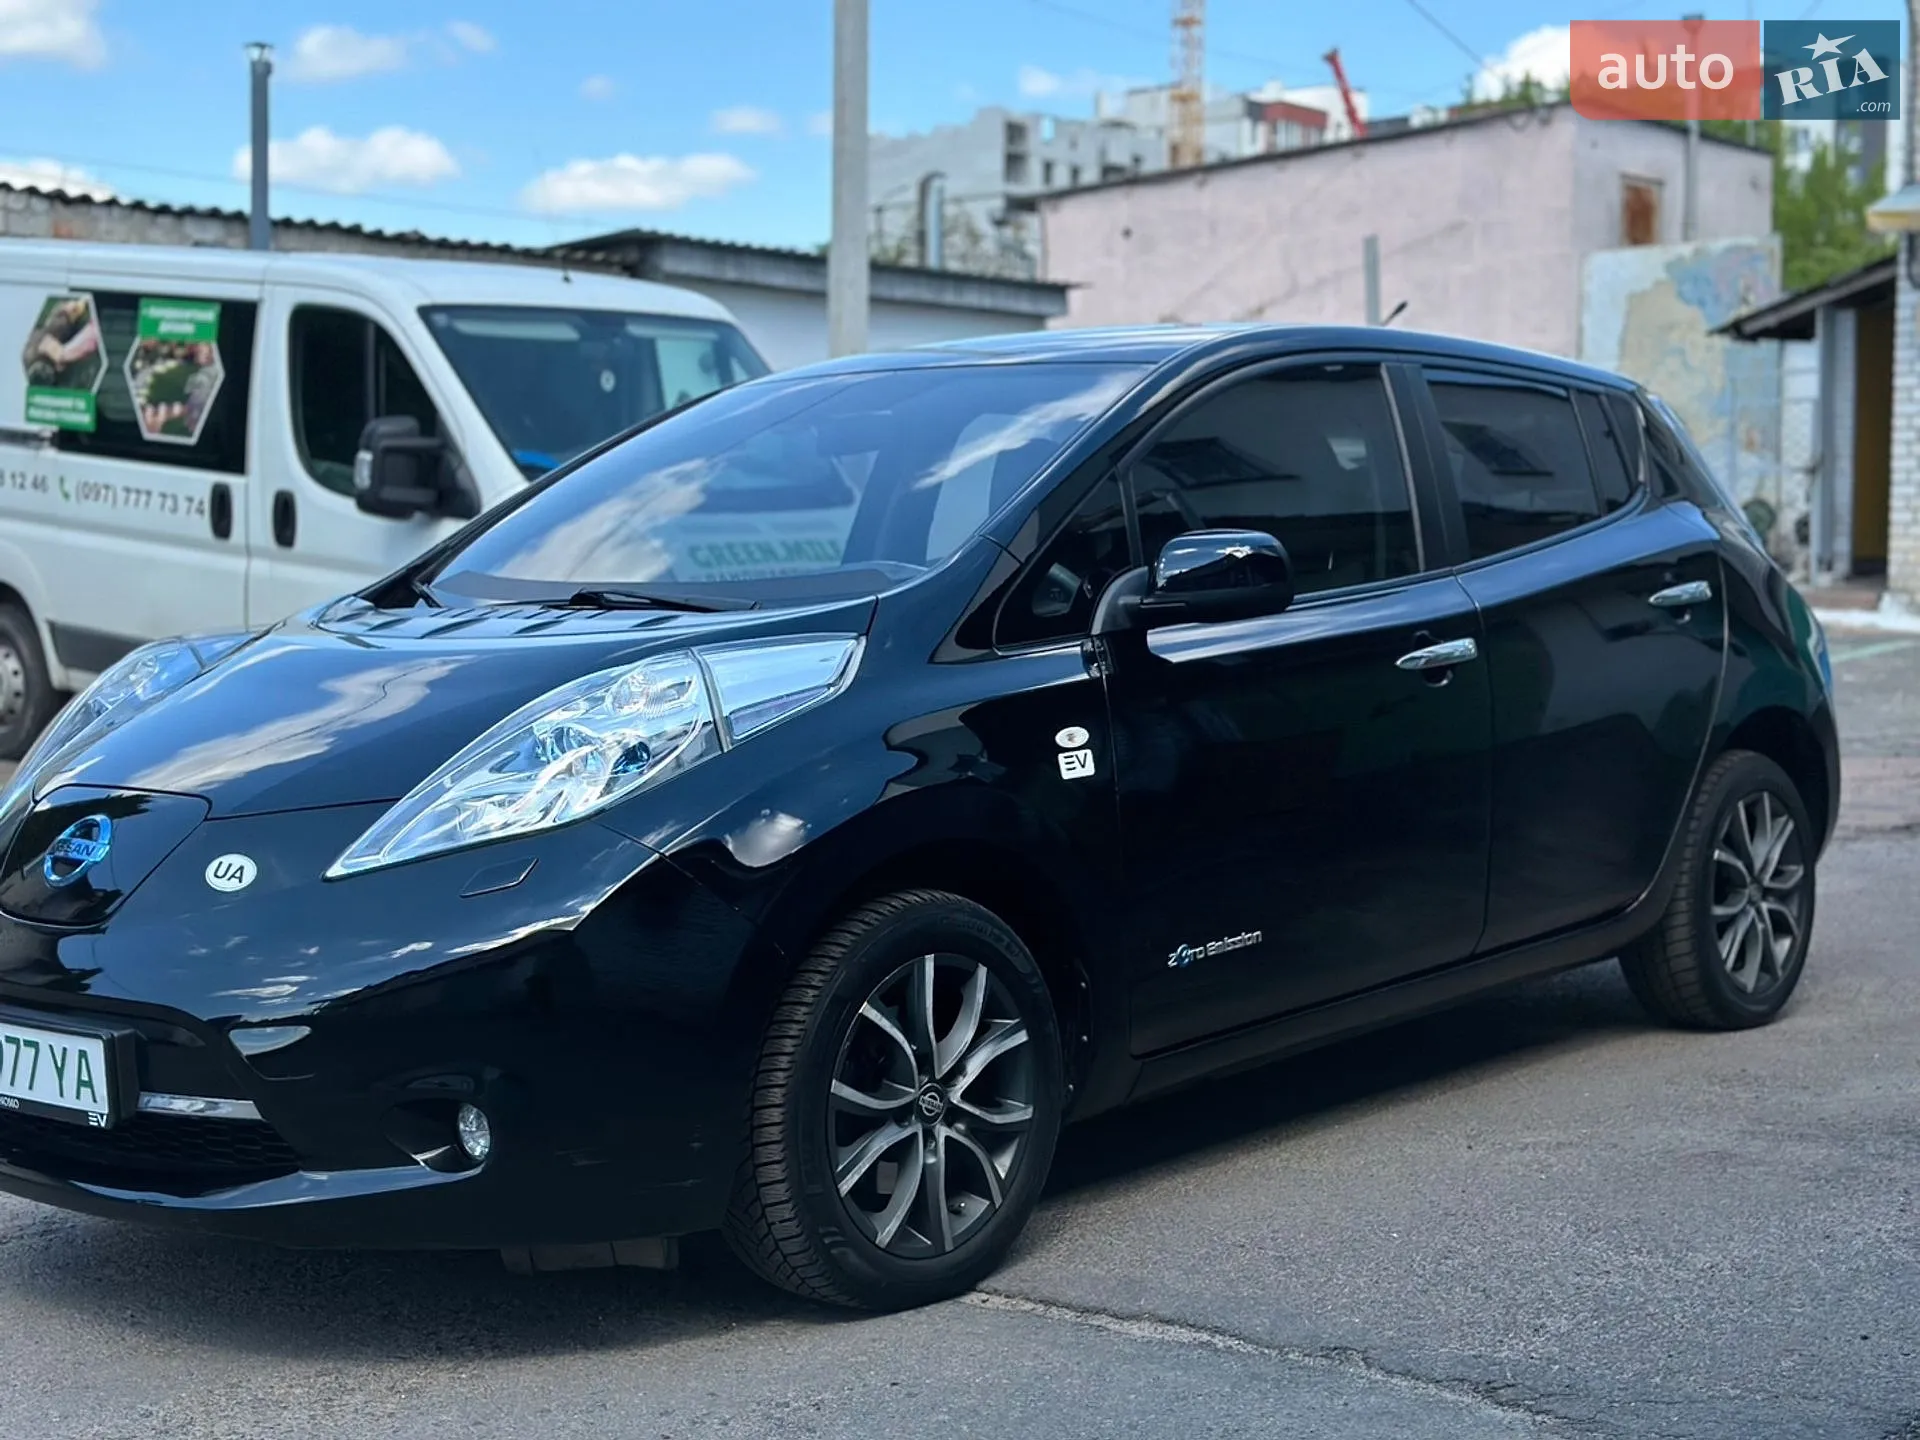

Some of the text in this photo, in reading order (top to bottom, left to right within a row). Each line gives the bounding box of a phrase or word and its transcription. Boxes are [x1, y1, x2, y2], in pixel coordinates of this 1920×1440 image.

[10, 471, 26, 490] 12
[75, 478, 206, 517] (097) 777 73 74
[1063, 752, 1087, 771] EV
[213, 860, 246, 884] UA
[0, 1034, 98, 1104] 77 YA
[88, 1112, 107, 1127] EV
